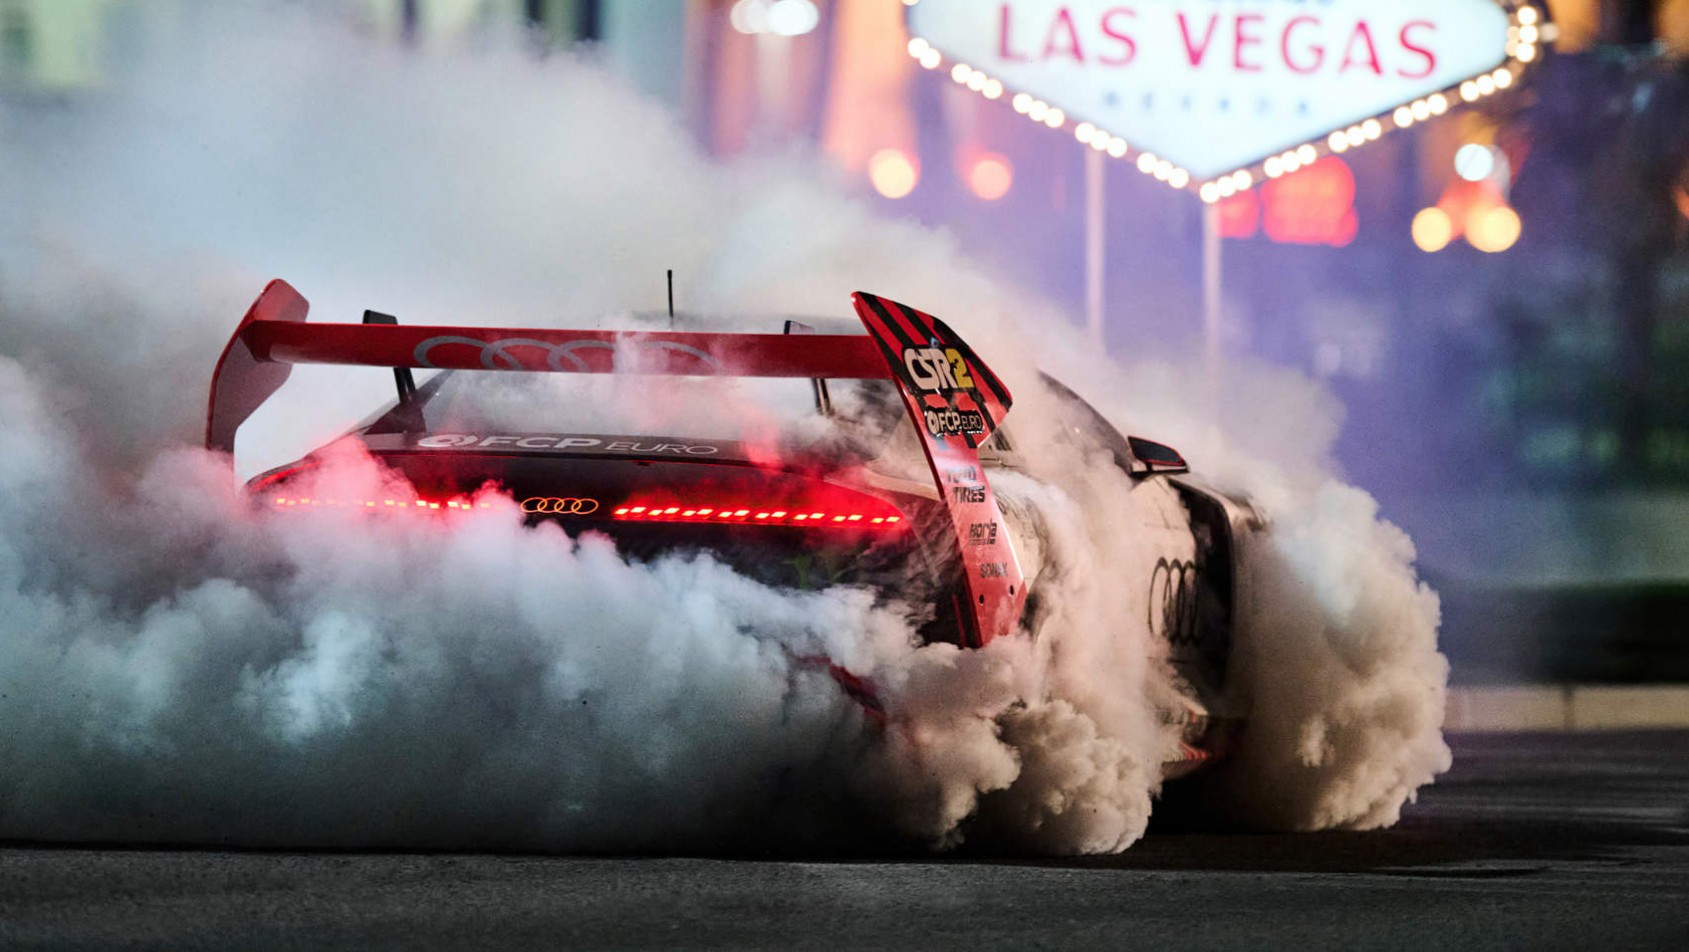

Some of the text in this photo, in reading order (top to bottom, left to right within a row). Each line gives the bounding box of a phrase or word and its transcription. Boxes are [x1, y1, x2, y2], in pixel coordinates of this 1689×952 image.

[997, 4, 1438, 80] LAS VEGAS
[904, 348, 974, 390] CSR2
[938, 411, 982, 431] FCP EURO
[478, 435, 718, 455] FCP EURO
[953, 485, 986, 503] TIRES
